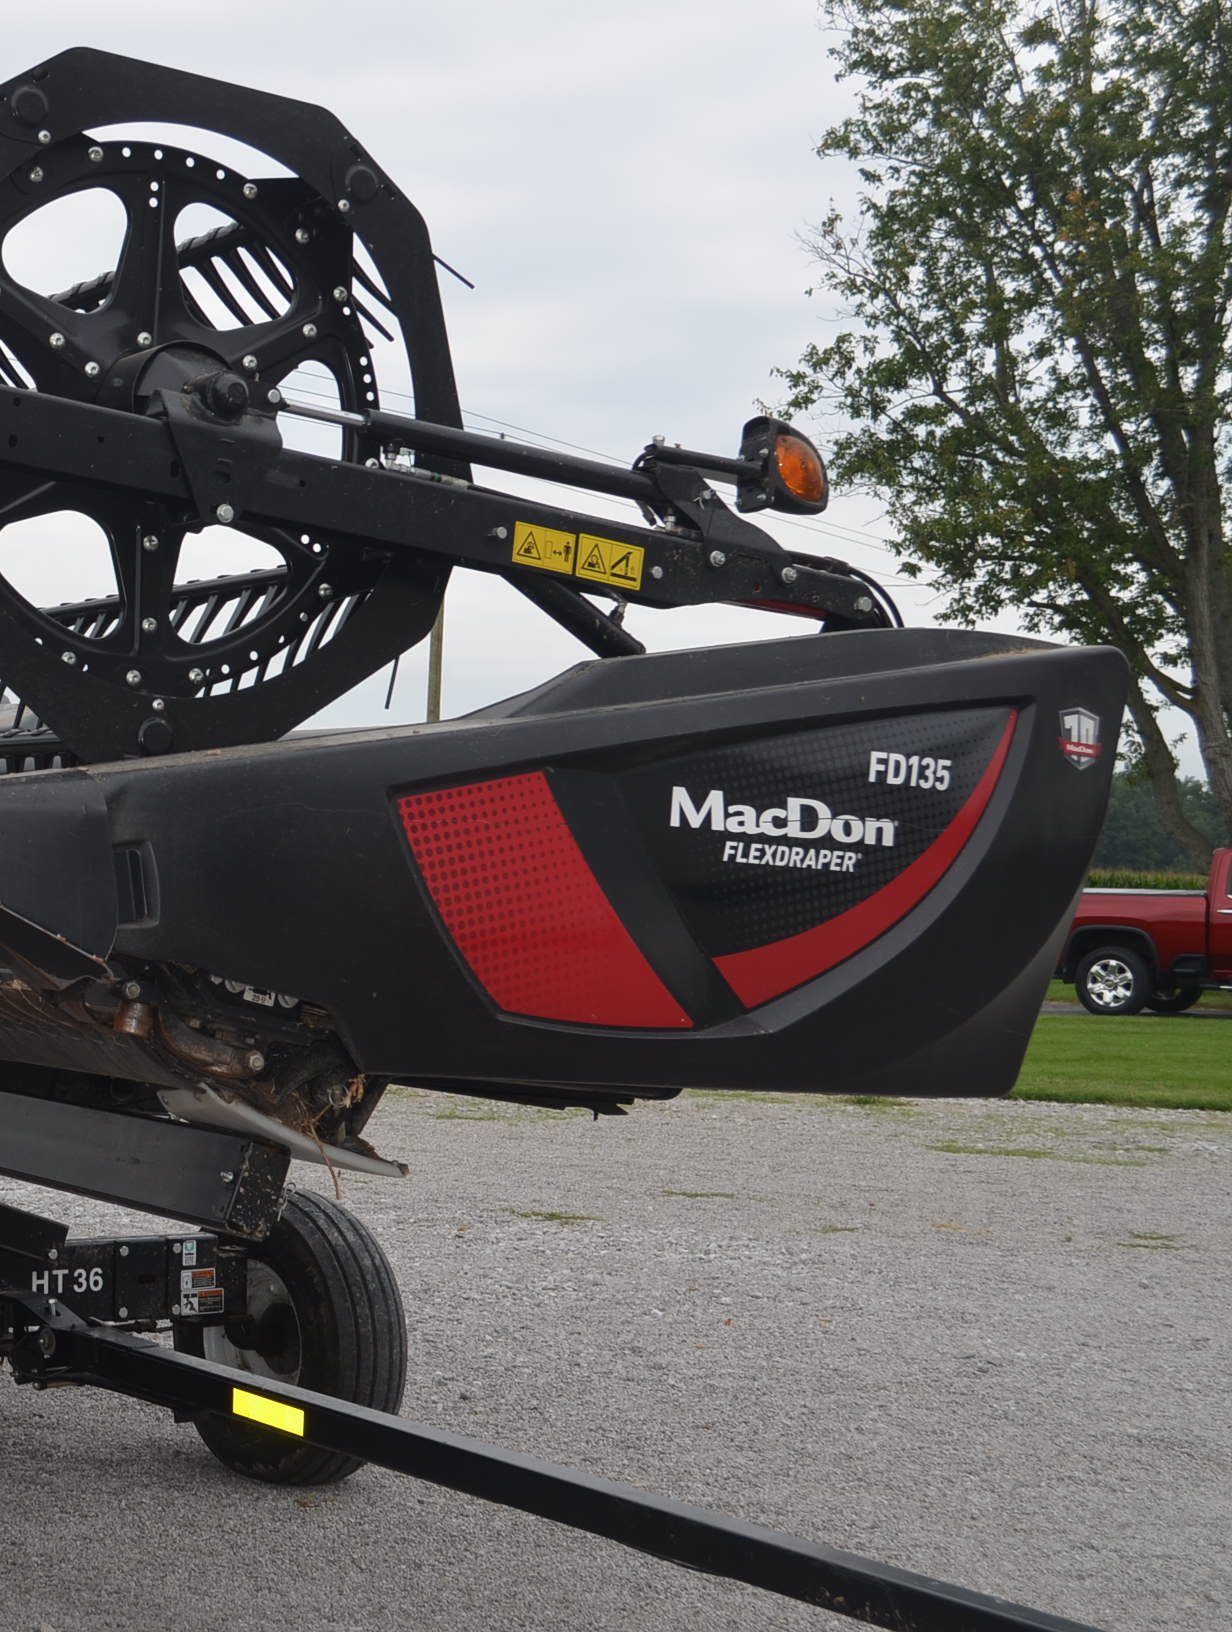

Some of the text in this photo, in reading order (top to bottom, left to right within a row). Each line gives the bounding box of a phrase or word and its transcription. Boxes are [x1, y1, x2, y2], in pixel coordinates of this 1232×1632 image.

[868, 750, 953, 791] FD135
[669, 785, 897, 847] MacDon
[722, 840, 859, 873] FLEXDRAPER
[31, 1267, 105, 1295] HT 36
